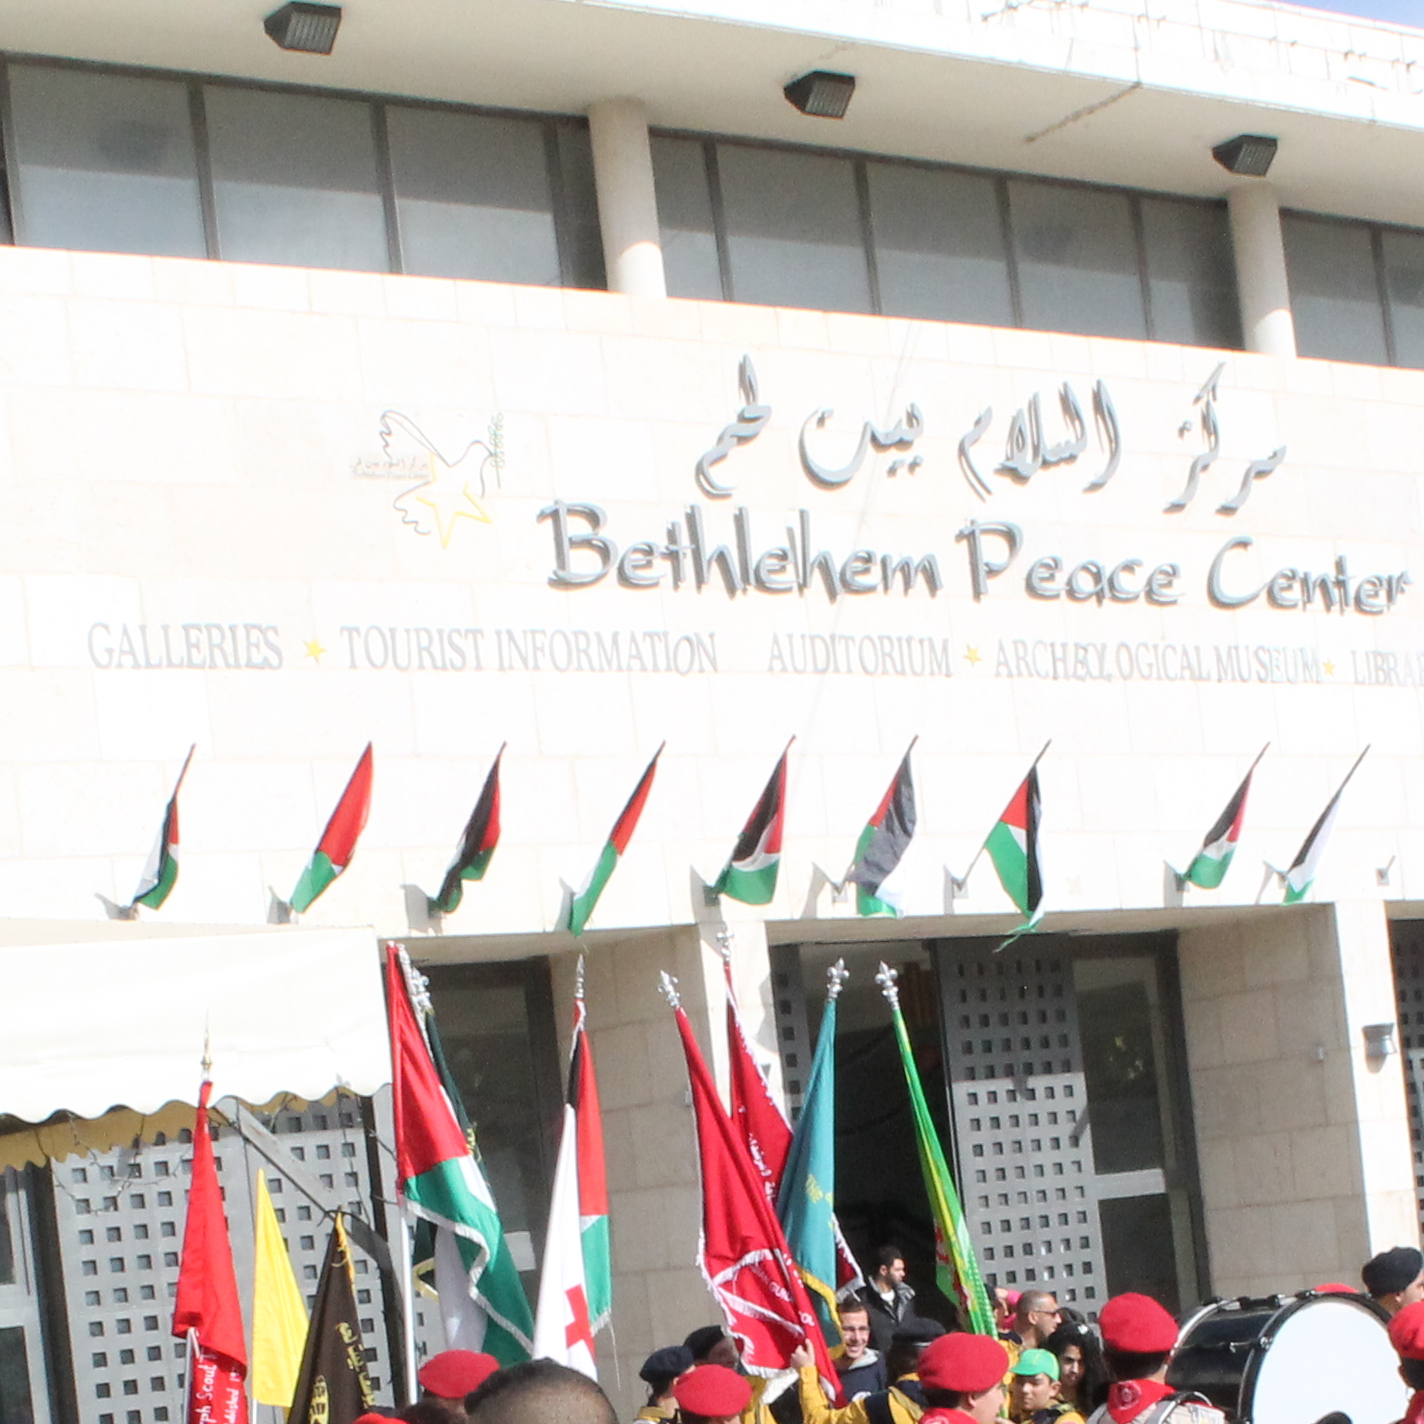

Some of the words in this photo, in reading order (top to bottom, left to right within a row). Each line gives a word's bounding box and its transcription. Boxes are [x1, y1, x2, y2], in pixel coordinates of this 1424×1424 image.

[692, 352, 773, 499] لحم
[956, 377, 1123, 502] السلام
[536, 499, 945, 598] Bethlehem
[954, 517, 1185, 607] Peace
[1205, 533, 1415, 619] Center
[87, 622, 284, 671] GALLERIES
[339, 625, 484, 673] TOURIST
[495, 627, 719, 677] INFORMATION
[766, 632, 952, 677] AUDITORIUM
[1212, 644, 1323, 684] MUSEUM
[195, 1363, 217, 1400] Scout
